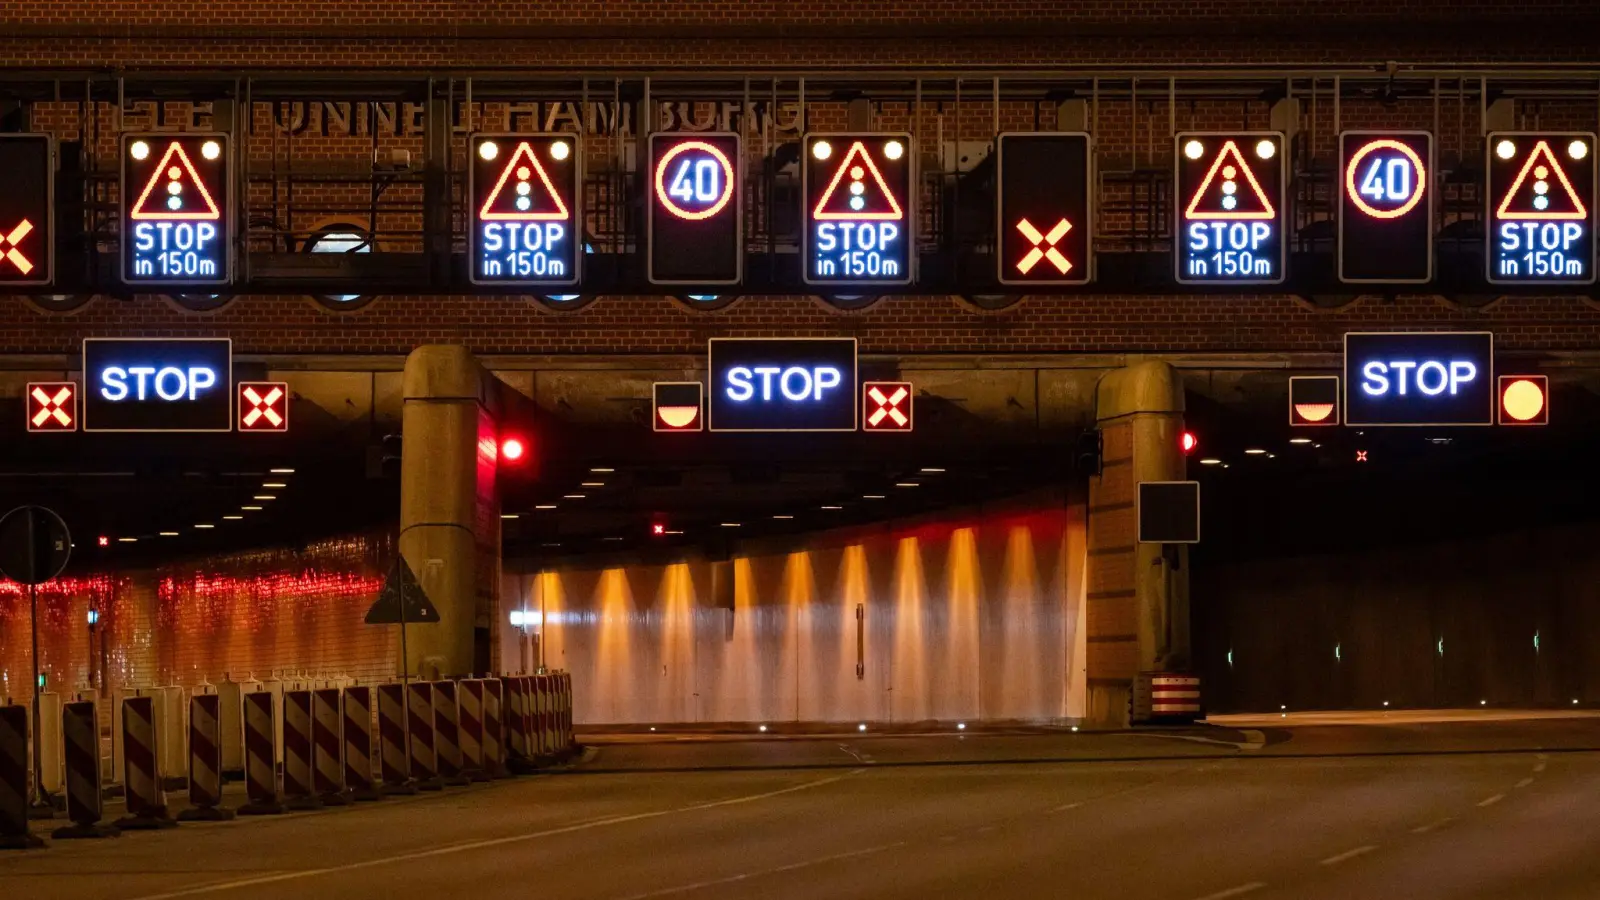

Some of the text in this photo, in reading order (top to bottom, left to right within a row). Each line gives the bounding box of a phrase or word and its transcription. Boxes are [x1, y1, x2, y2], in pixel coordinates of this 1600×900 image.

[112, 100, 474, 133] ELUNNEL
[669, 160, 717, 201] 40
[1360, 158, 1409, 200] 40
[135, 222, 216, 250] STOP
[483, 222, 564, 250] STOP
[817, 222, 898, 250] STOP
[1189, 222, 1270, 250] STOP
[1501, 222, 1582, 250] STOP
[135, 253, 152, 275] in
[483, 253, 500, 275] in
[817, 253, 834, 275] in
[1189, 253, 1206, 275] in
[1501, 253, 1518, 275] in
[101, 367, 216, 401] STOP
[727, 366, 841, 402] STOP
[1362, 361, 1476, 396] STOP
